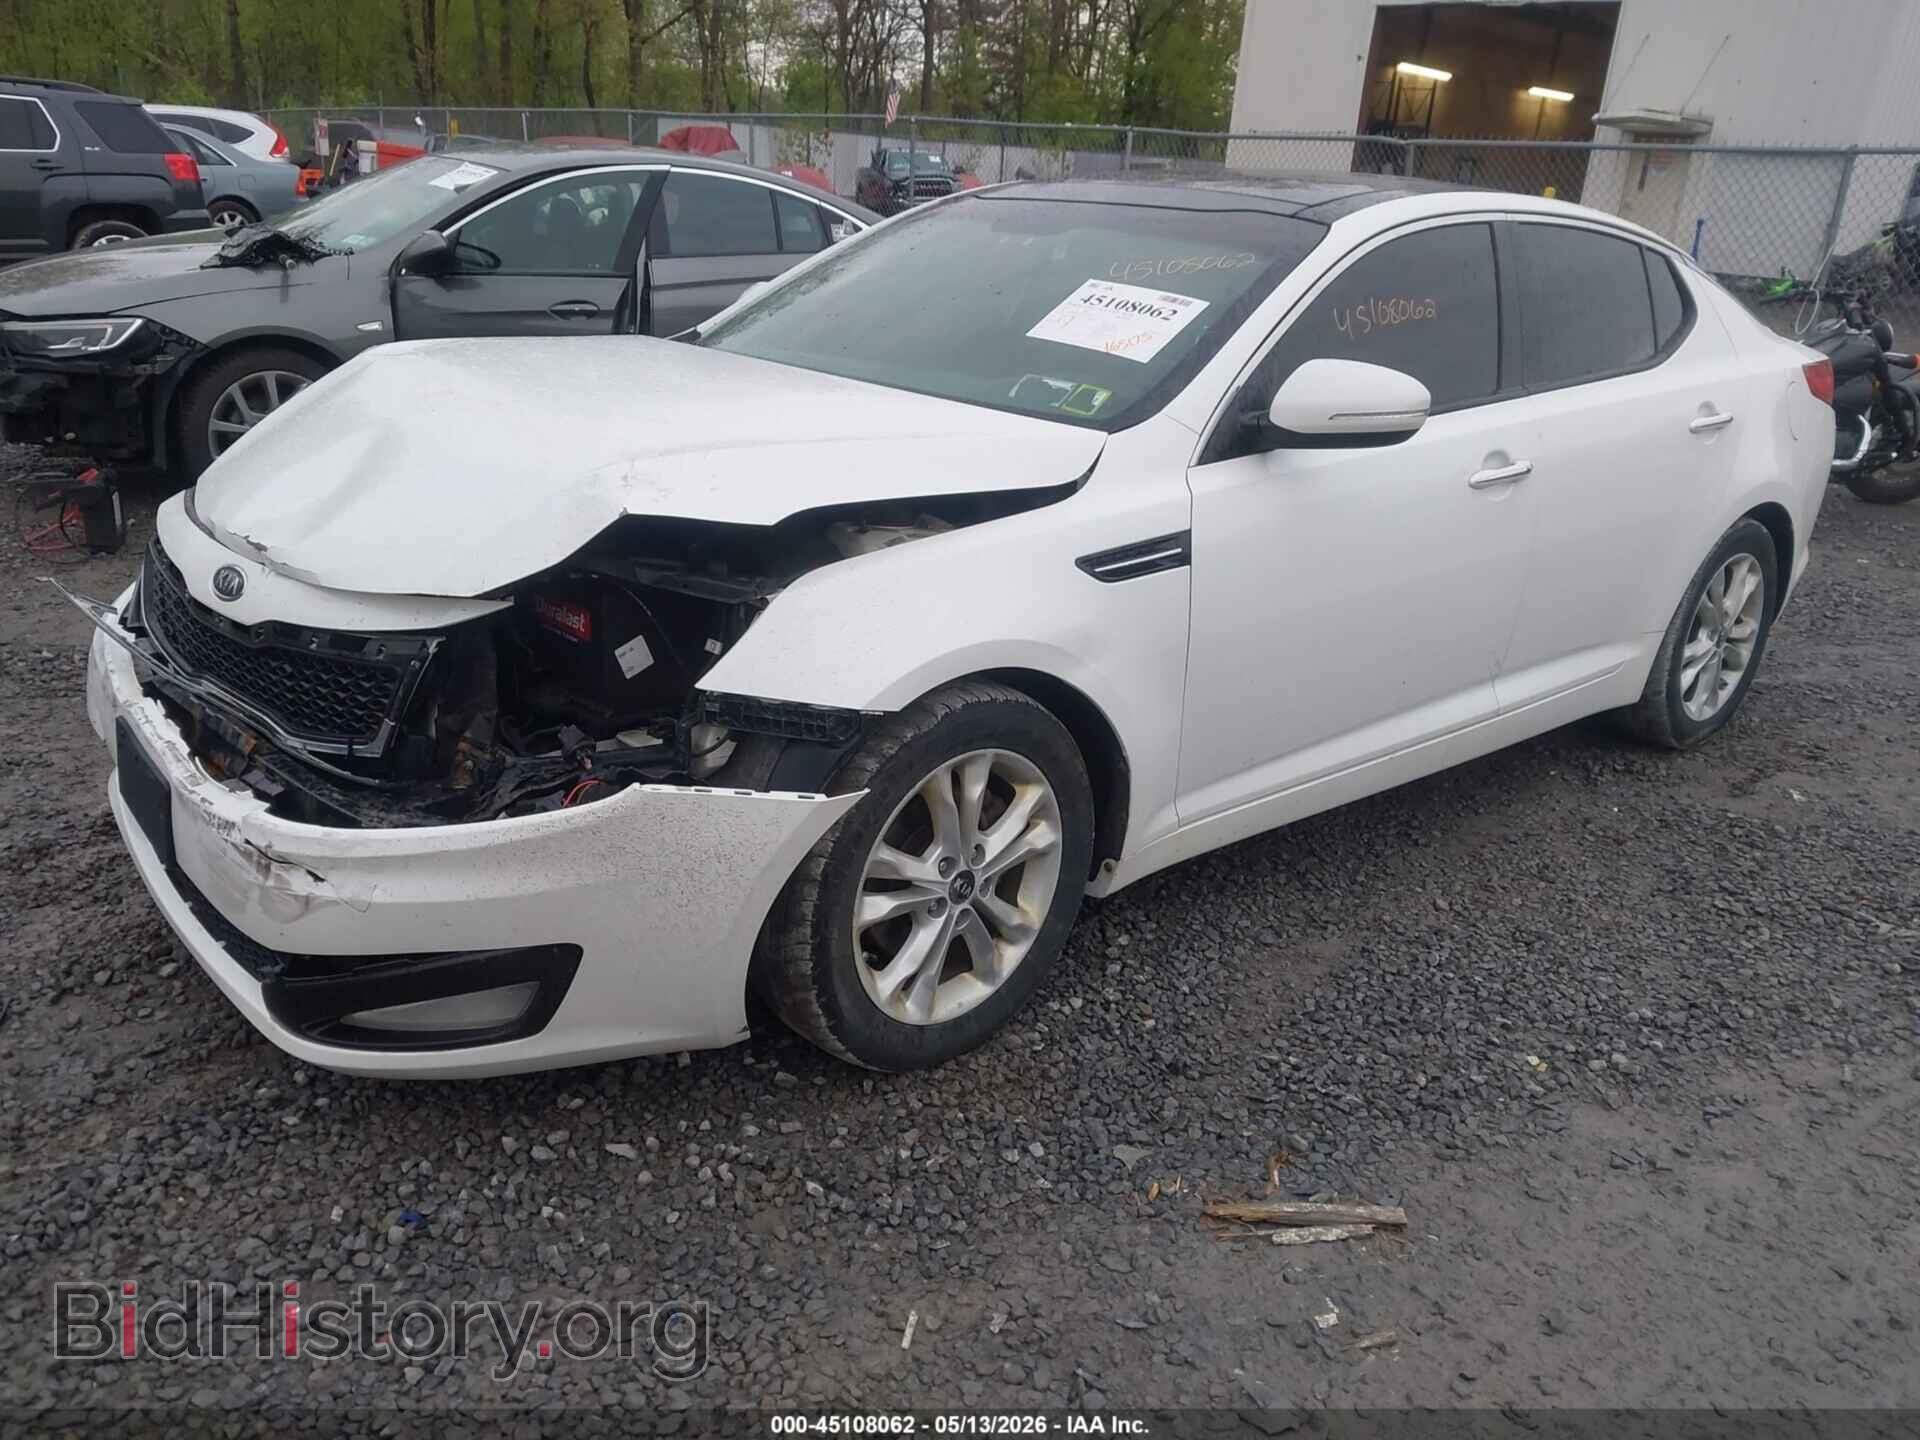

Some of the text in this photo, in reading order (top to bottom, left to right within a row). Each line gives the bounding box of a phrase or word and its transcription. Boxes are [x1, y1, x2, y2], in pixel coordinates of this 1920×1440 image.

[1109, 251, 1256, 281] 45108062
[1080, 293, 1178, 322] 45108062
[1333, 297, 1438, 339] 45108062
